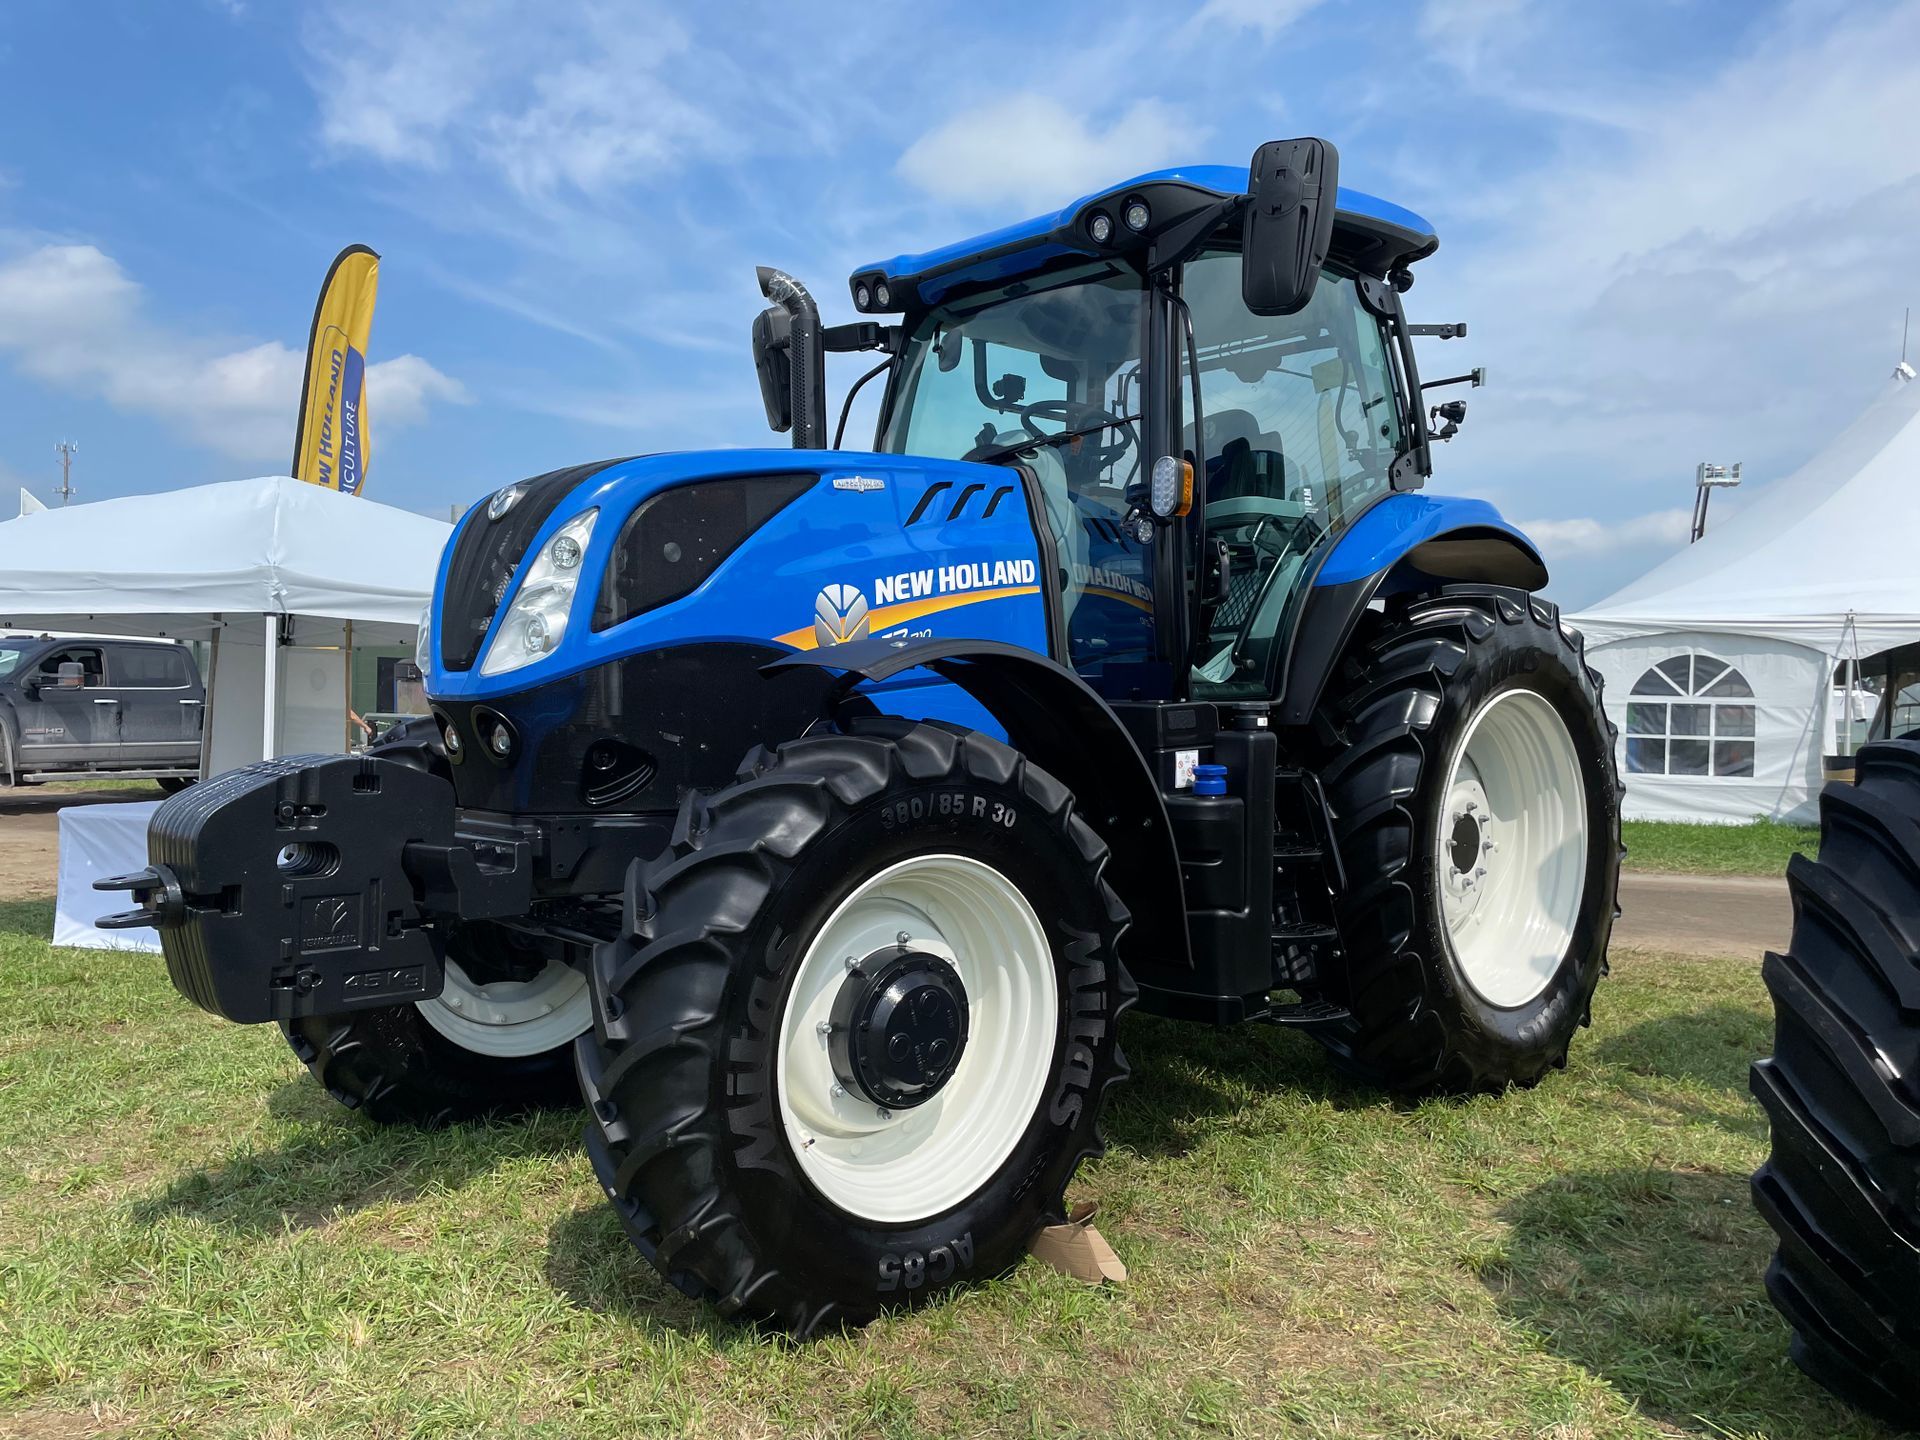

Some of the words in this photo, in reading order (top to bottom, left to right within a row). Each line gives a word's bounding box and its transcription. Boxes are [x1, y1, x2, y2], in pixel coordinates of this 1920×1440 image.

[319, 349, 343, 458] HOLLAND
[875, 569, 933, 605] NEW
[938, 559, 1035, 591] HOLLAND
[972, 796, 987, 818] R
[992, 803, 1017, 828] 30
[1049, 918, 1107, 1131] Mitas
[876, 1231, 975, 1292] AC85
